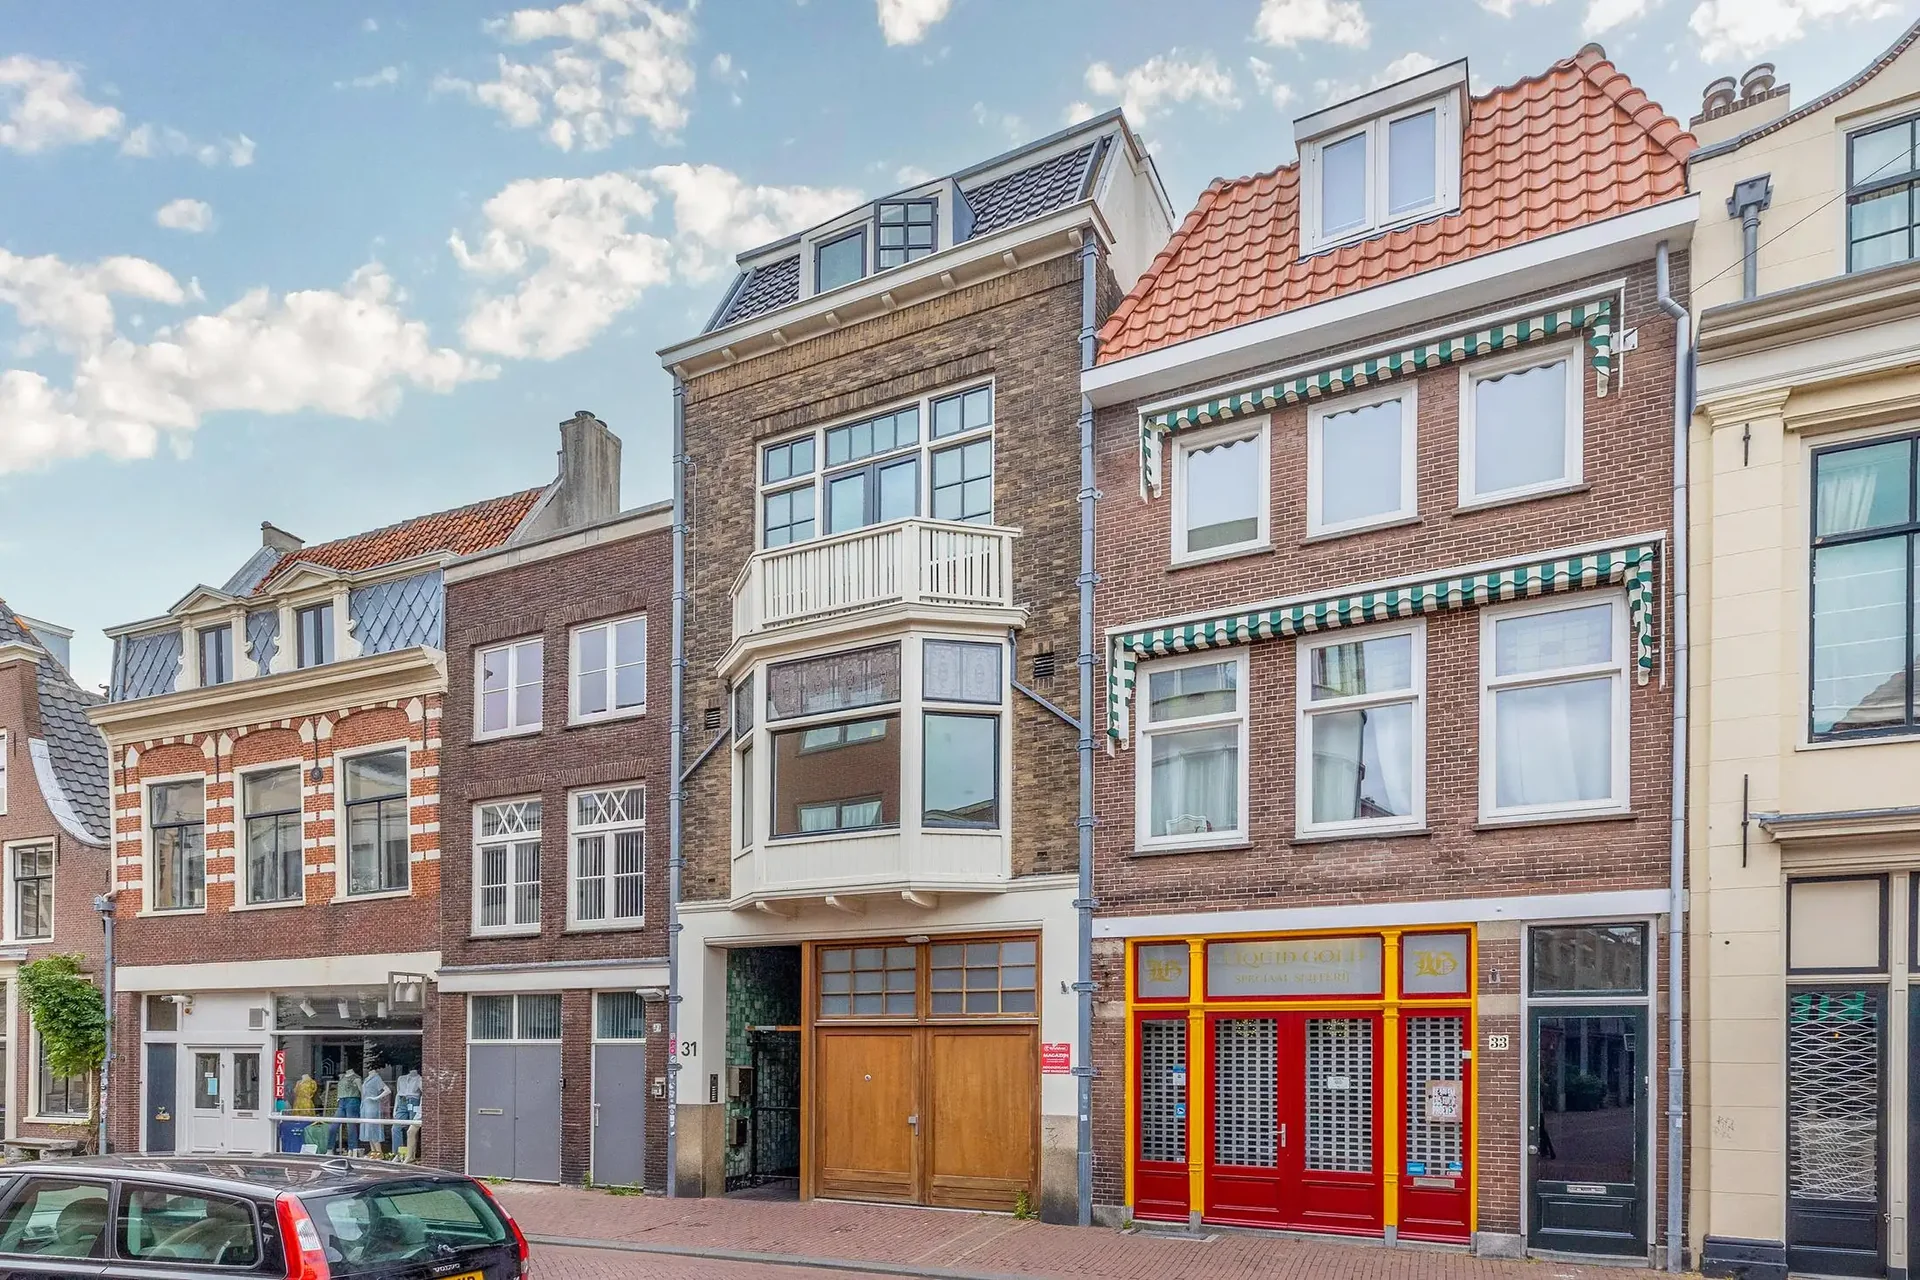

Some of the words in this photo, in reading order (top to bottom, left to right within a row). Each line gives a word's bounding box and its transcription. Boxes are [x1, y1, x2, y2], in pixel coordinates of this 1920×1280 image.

[681, 1041, 697, 1057] 31
[1490, 1036, 1507, 1048] 33
[276, 1052, 285, 1097] SALE
[433, 1263, 460, 1272] VOLVO
